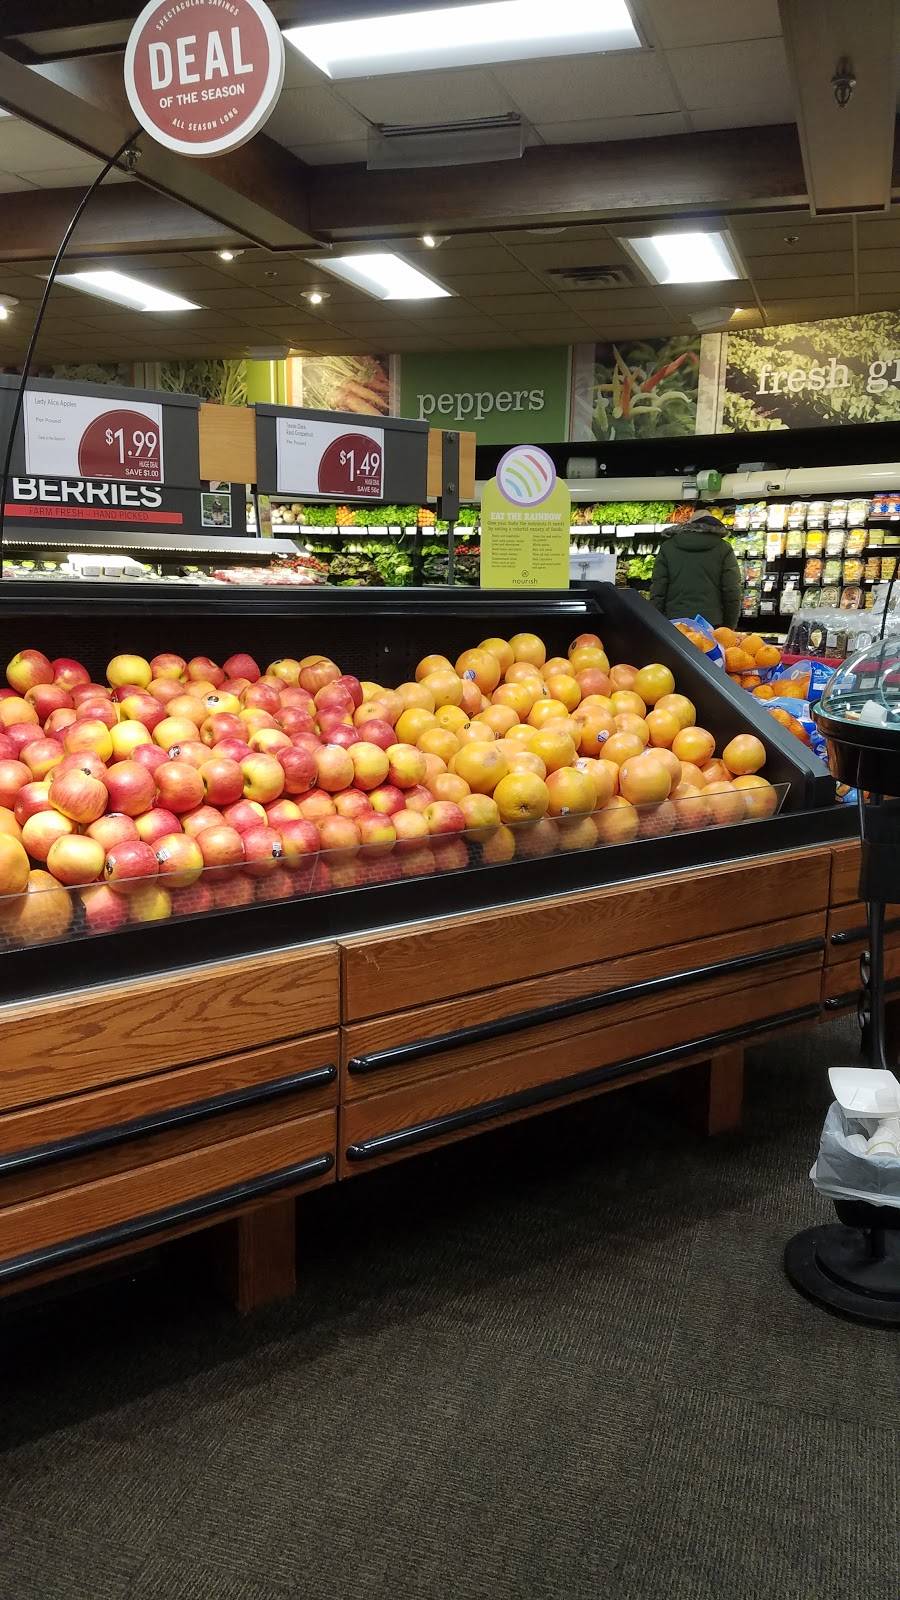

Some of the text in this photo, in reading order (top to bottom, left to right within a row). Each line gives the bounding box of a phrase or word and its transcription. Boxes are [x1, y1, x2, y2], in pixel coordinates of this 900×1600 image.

[156, 0, 239, 31] SPECTACULAR SAVINGS
[148, 27, 254, 90] DEAL
[159, 83, 245, 108] OF THE SEASON
[172, 107, 239, 131] ALL SEASON LONG
[756, 358, 850, 395] fresh
[60, 400, 77, 408] Apples
[416, 389, 545, 421] peppers
[105, 428, 157, 464] $1.99
[125, 468, 143, 476] SAVE
[339, 449, 380, 482] $1.49
[12, 477, 163, 508] BERRIES
[29, 507, 53, 517] FARM
[55, 508, 84, 518] FRESH
[94, 510, 117, 519] HAND
[119, 511, 149, 521] PICKED
[512, 577, 538, 585] nourish
